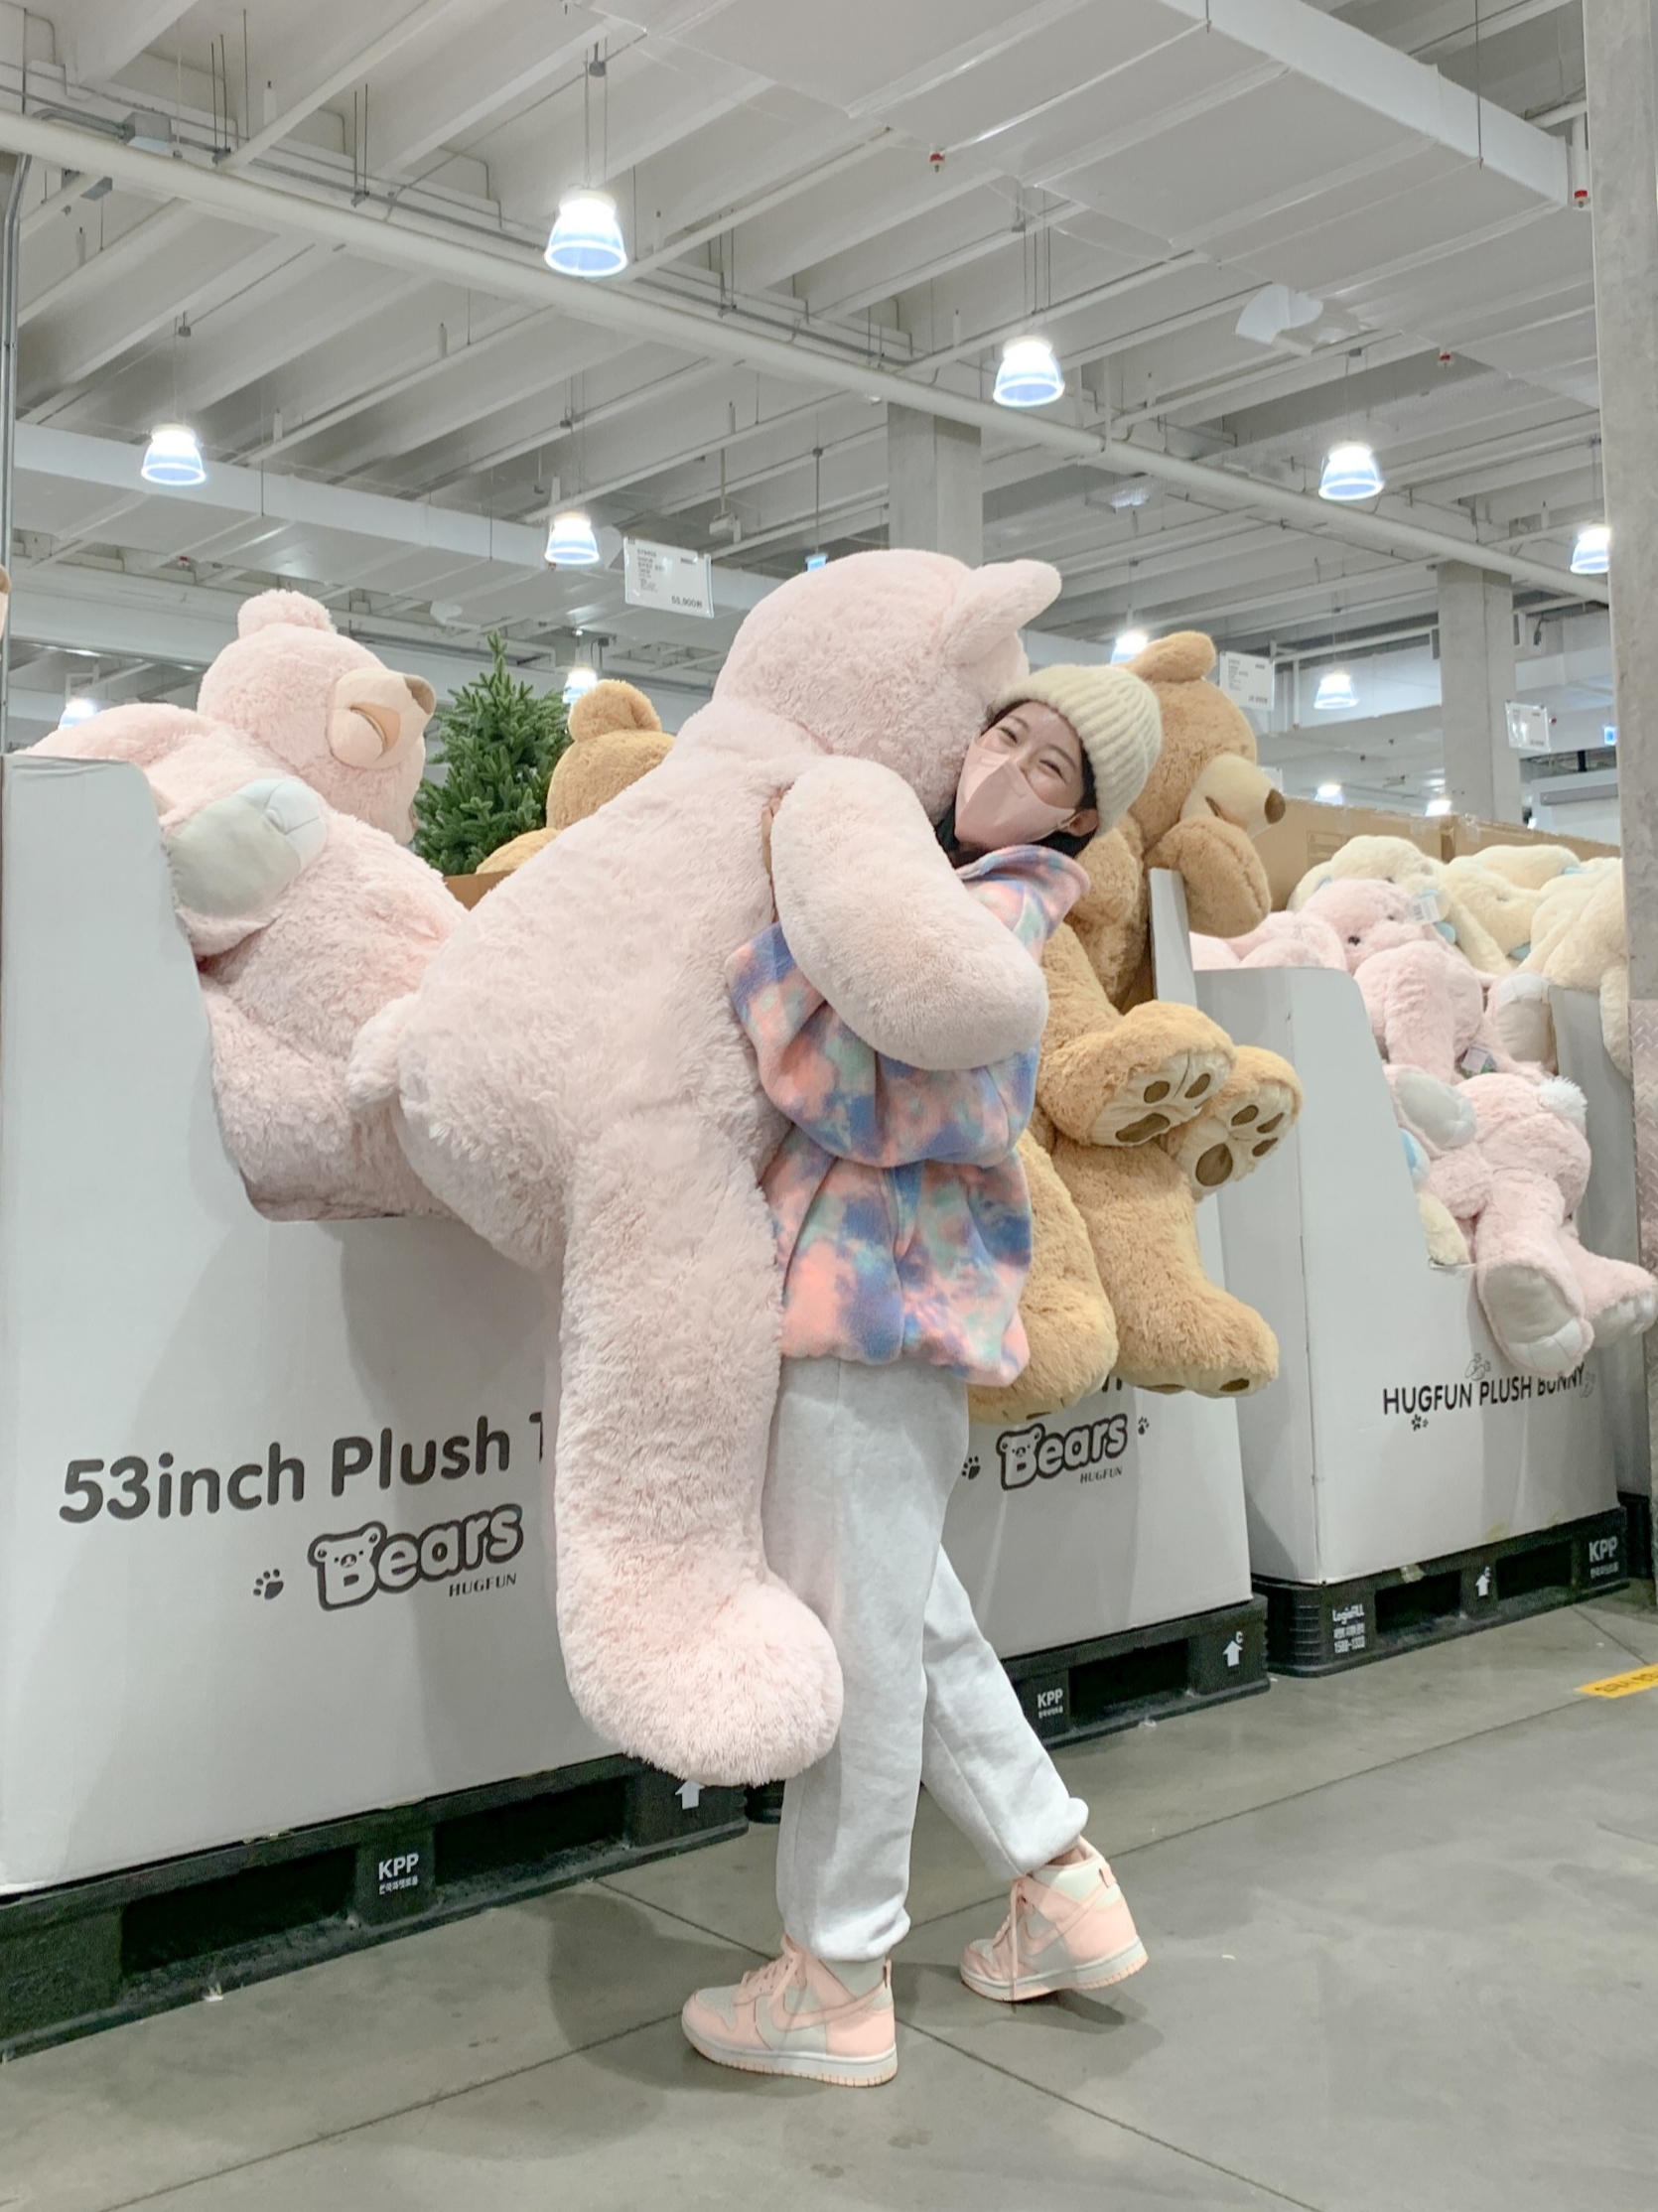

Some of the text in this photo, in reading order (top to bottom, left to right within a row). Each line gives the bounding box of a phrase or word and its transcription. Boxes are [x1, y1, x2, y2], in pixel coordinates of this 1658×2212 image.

[1382, 1382, 1472, 1415] HUGFUN
[1478, 1375, 1532, 1406] PLUSH
[996, 1412, 1129, 1490] Bears
[59, 1442, 306, 1523] 53inch
[331, 1416, 510, 1497] Plush
[1079, 1465, 1123, 1484] HUGFUN
[308, 1503, 525, 1611] Bears
[1589, 1535, 1618, 1563] KPP
[449, 1573, 518, 1597] HUGFUN
[1036, 1688, 1063, 1709] KPP
[378, 1853, 420, 1881] KPP
